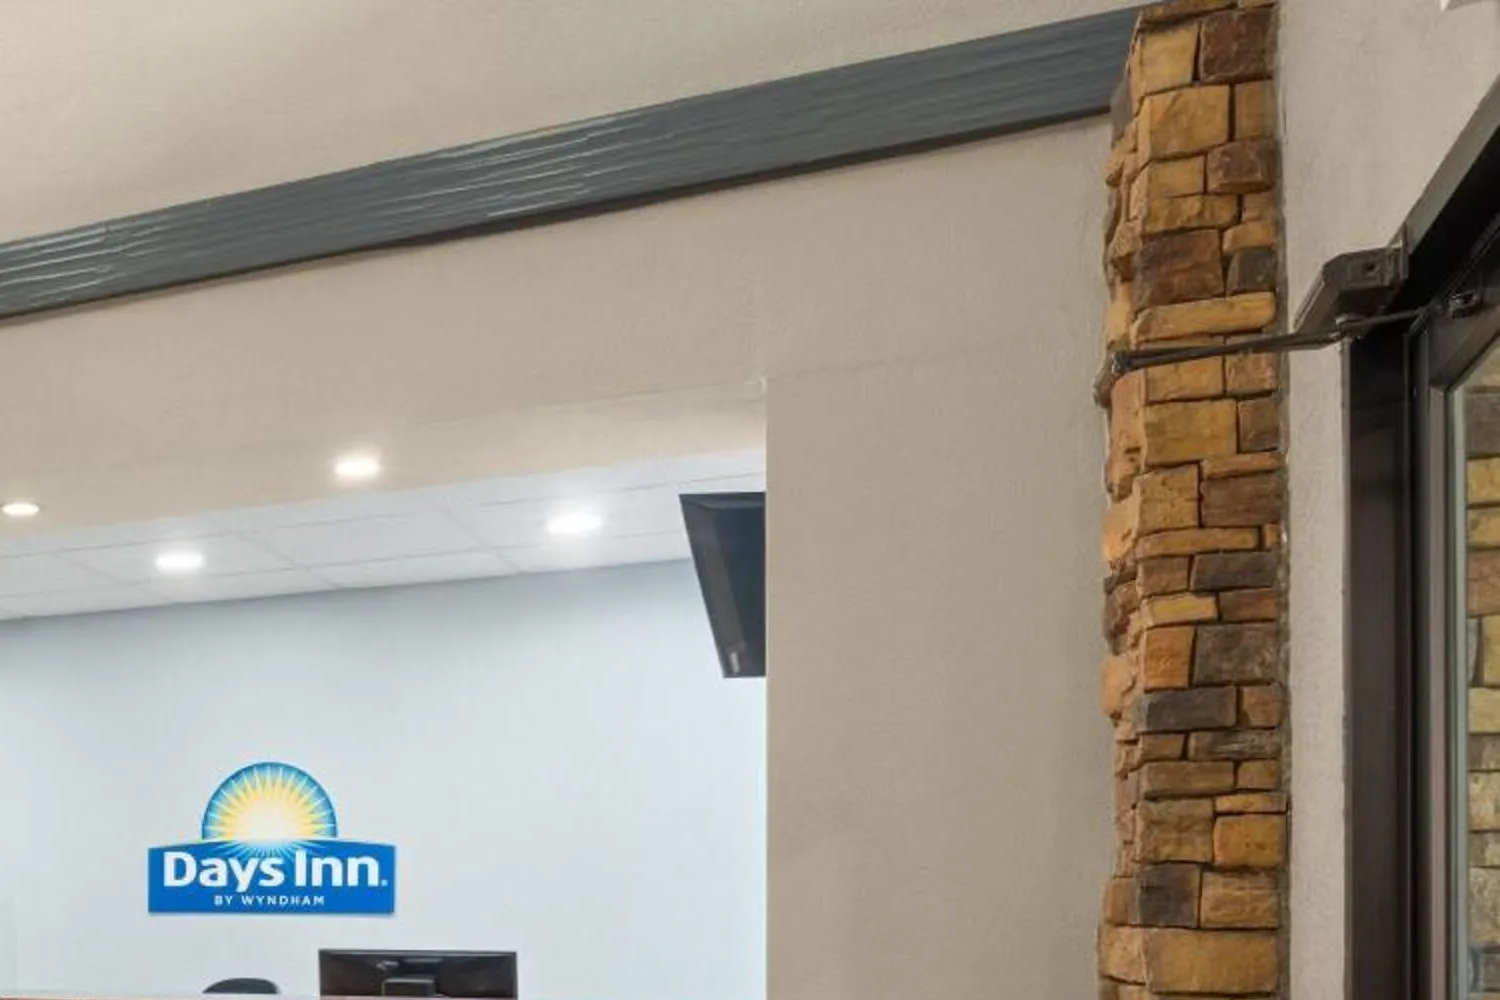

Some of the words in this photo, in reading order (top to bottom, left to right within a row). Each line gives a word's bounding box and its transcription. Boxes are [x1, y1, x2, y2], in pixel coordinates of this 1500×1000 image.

[163, 851, 285, 893] Days
[213, 895, 233, 906] BY
[241, 895, 325, 906] WYNDHAM
